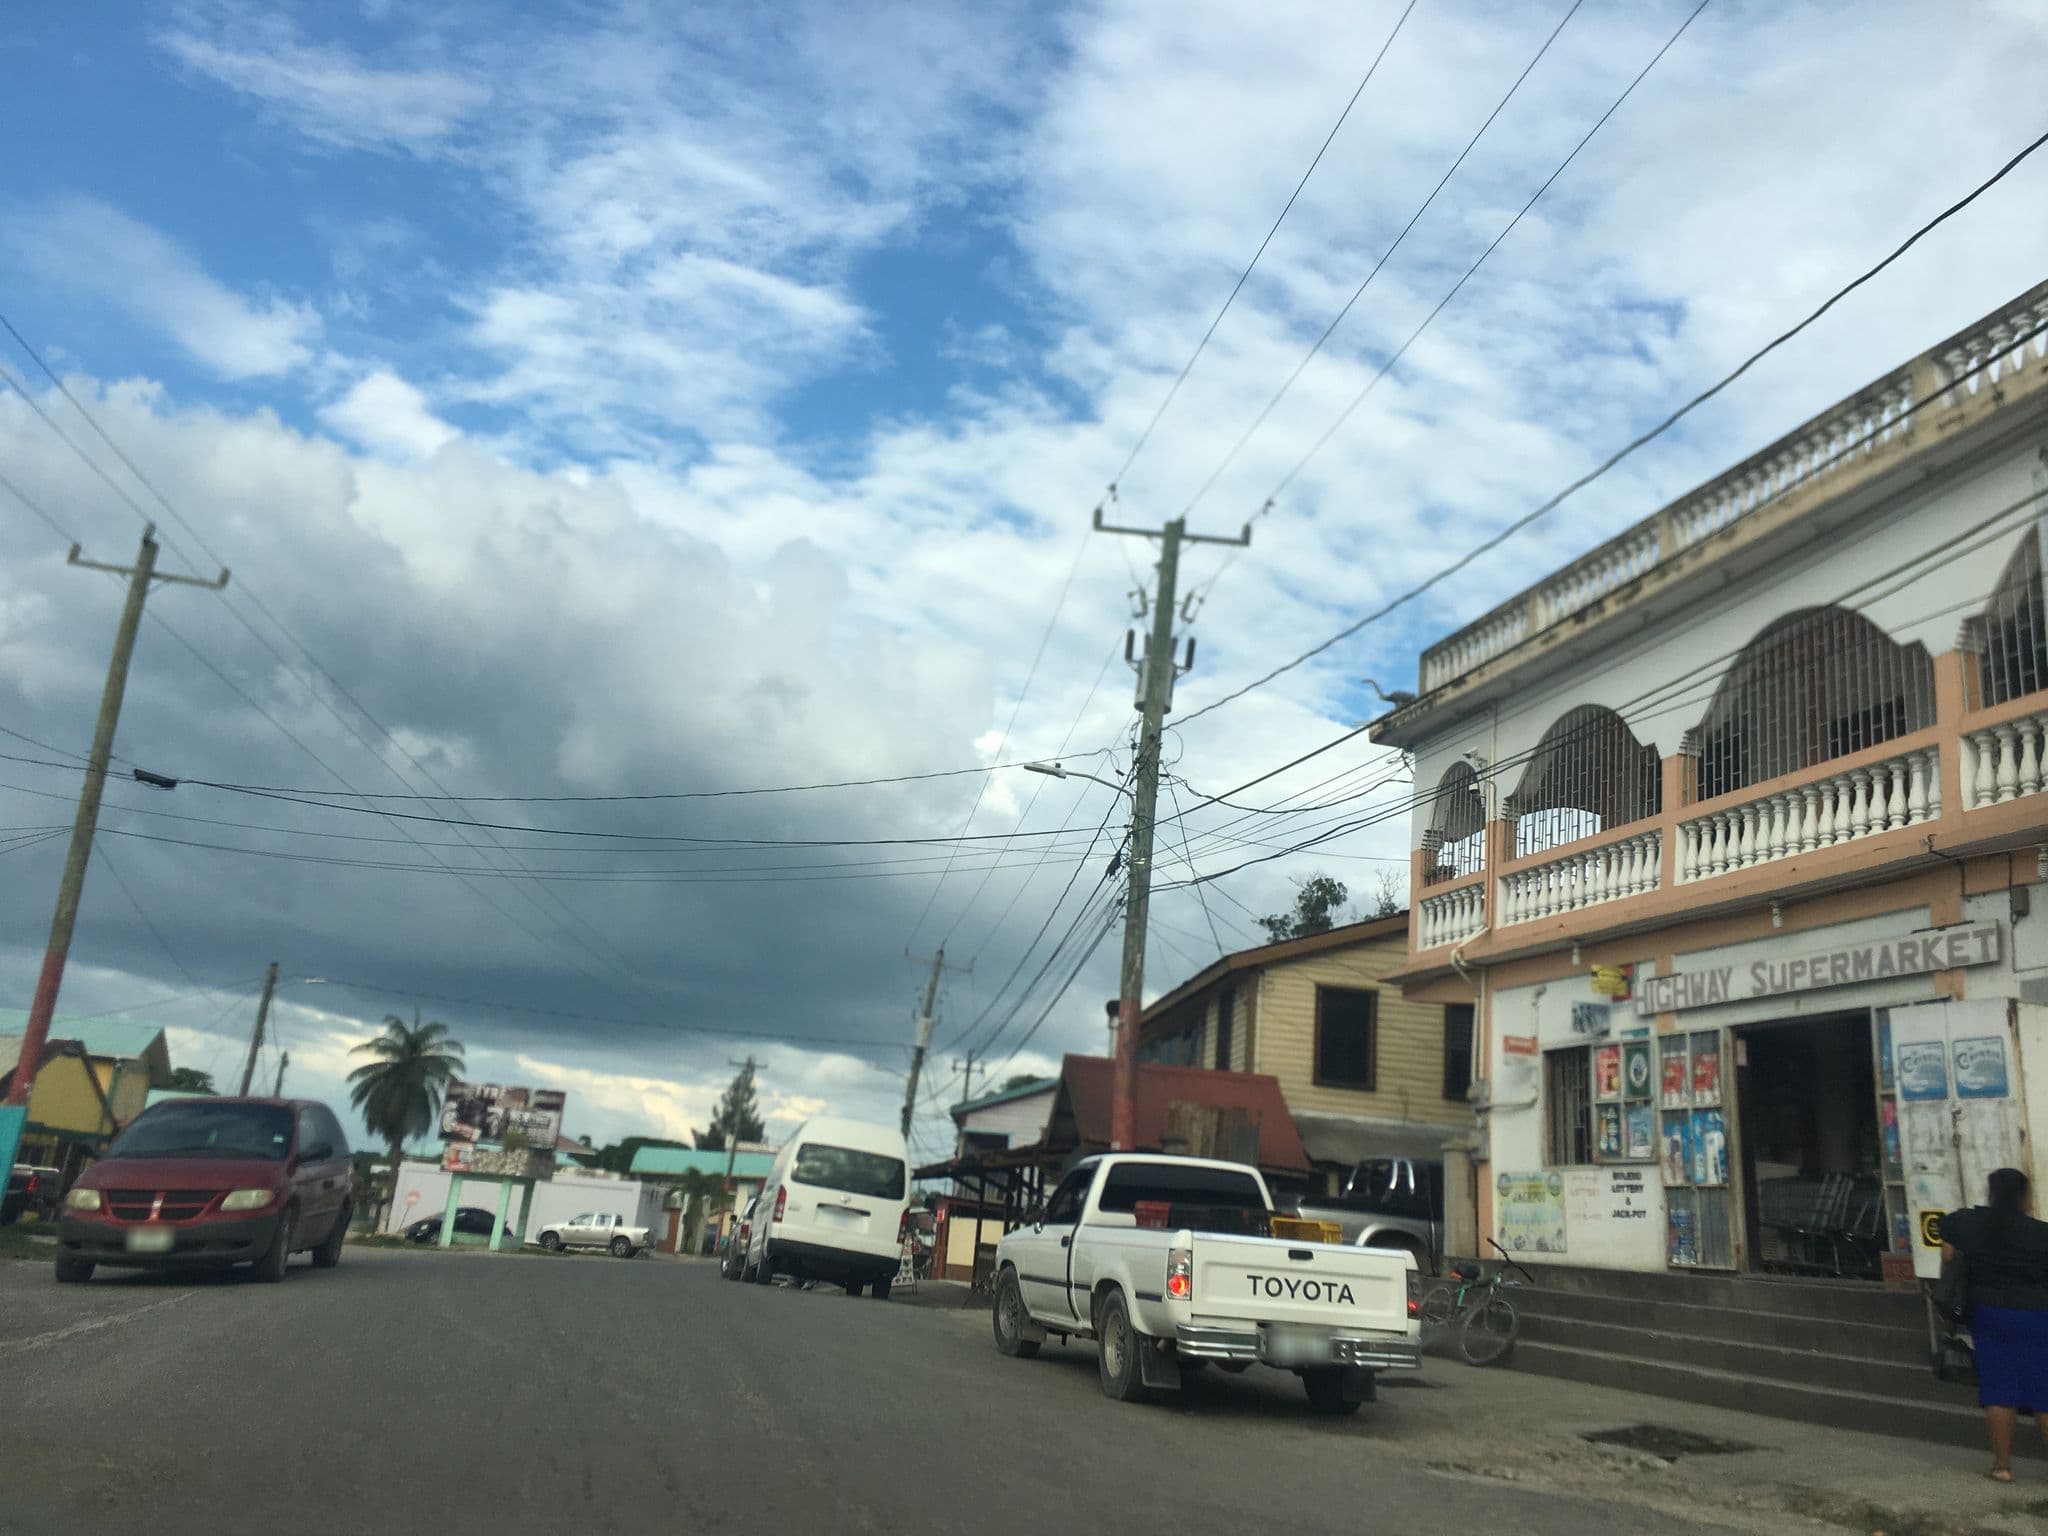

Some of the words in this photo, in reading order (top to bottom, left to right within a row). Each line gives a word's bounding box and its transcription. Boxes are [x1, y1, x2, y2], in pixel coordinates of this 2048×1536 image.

[1633, 966, 1733, 1014] HIGHWAY
[1751, 928, 1997, 996] SUPERMARKET
[1611, 1184, 1644, 1193] LOTTERY
[1246, 1274, 1356, 1305] TOYOTA
